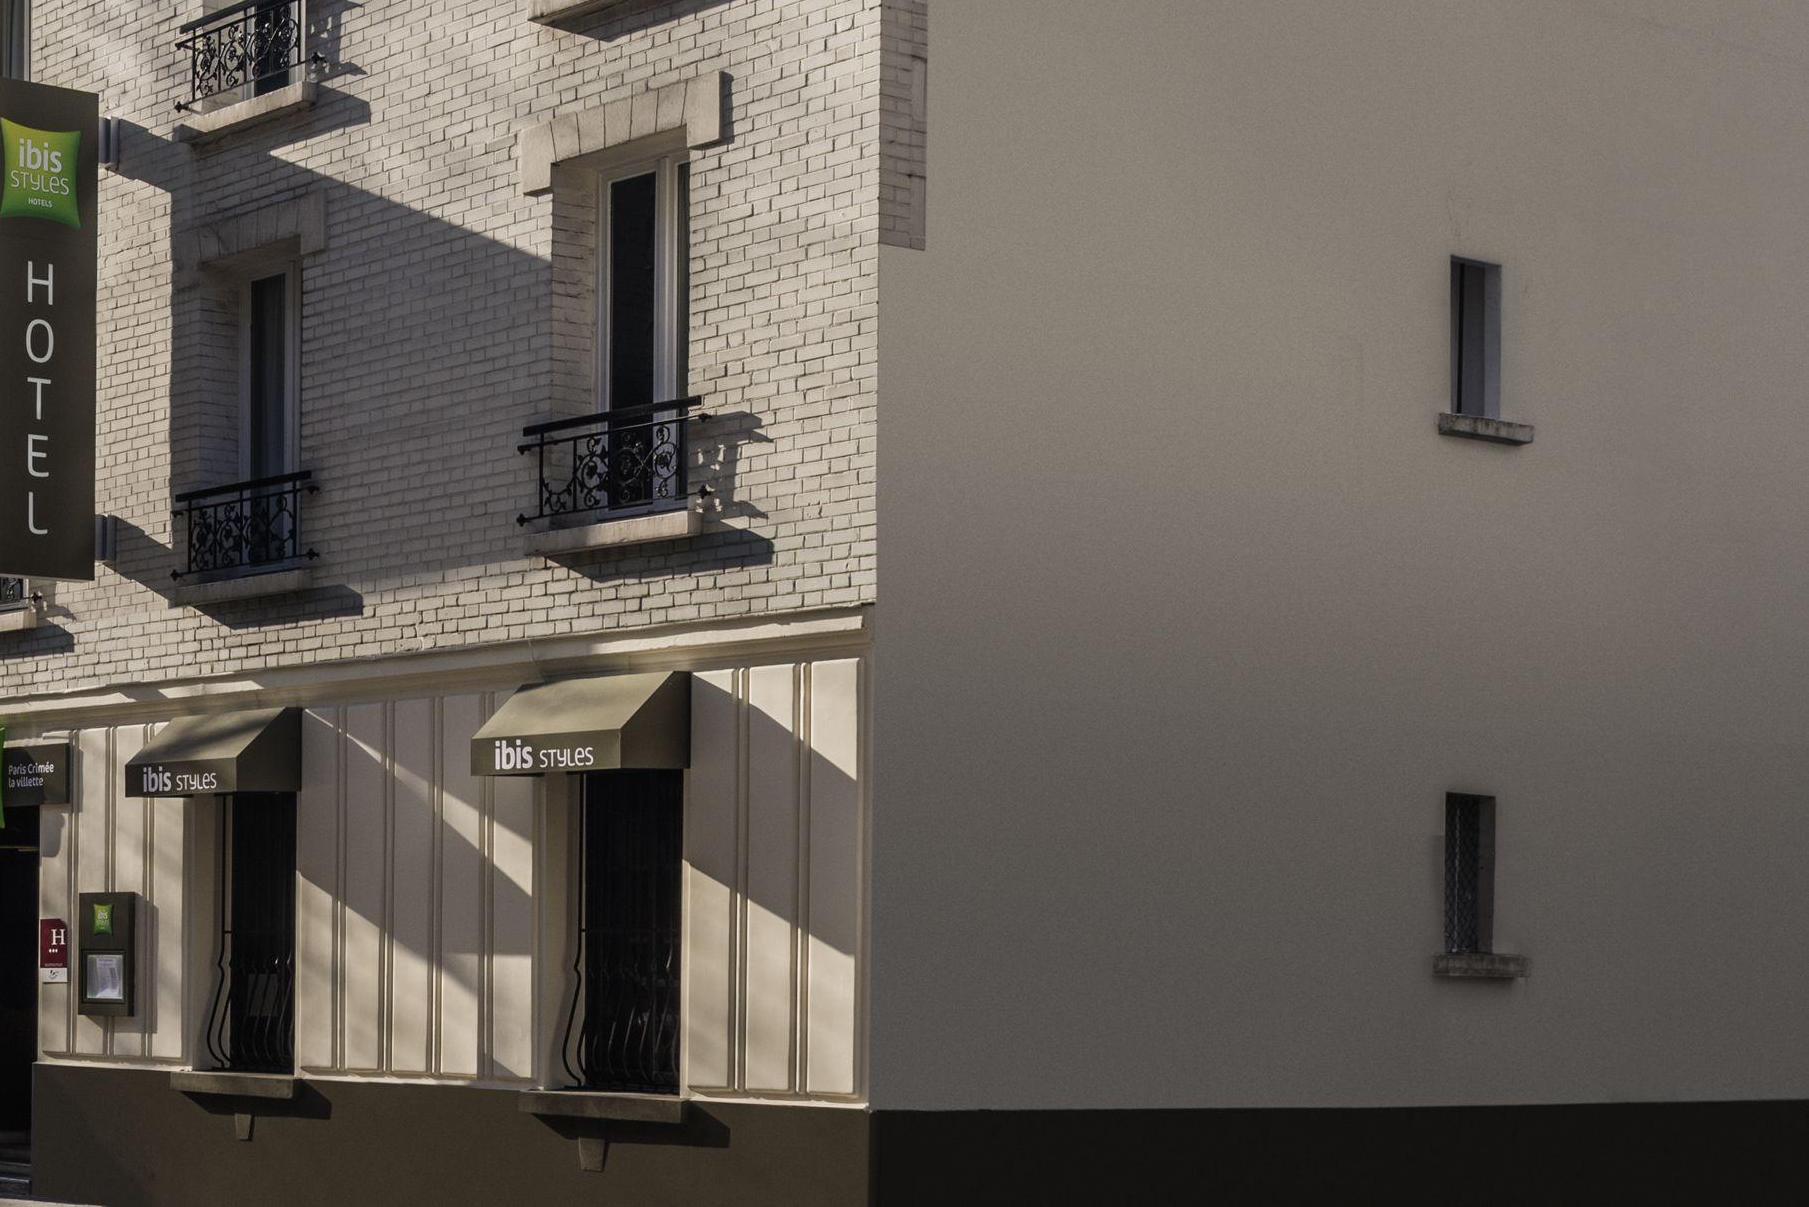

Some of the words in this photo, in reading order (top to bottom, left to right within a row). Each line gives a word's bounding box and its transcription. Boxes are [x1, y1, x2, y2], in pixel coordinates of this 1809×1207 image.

[19, 138, 62, 173] ibis
[28, 198, 53, 208] HOTELS
[25, 260, 54, 535] HOTEL
[495, 739, 533, 770] ibis
[9, 764, 26, 775] Paris
[28, 761, 55, 774] Crimée
[17, 776, 44, 787] villette
[143, 766, 171, 792] ibis
[51, 928, 66, 945] H
